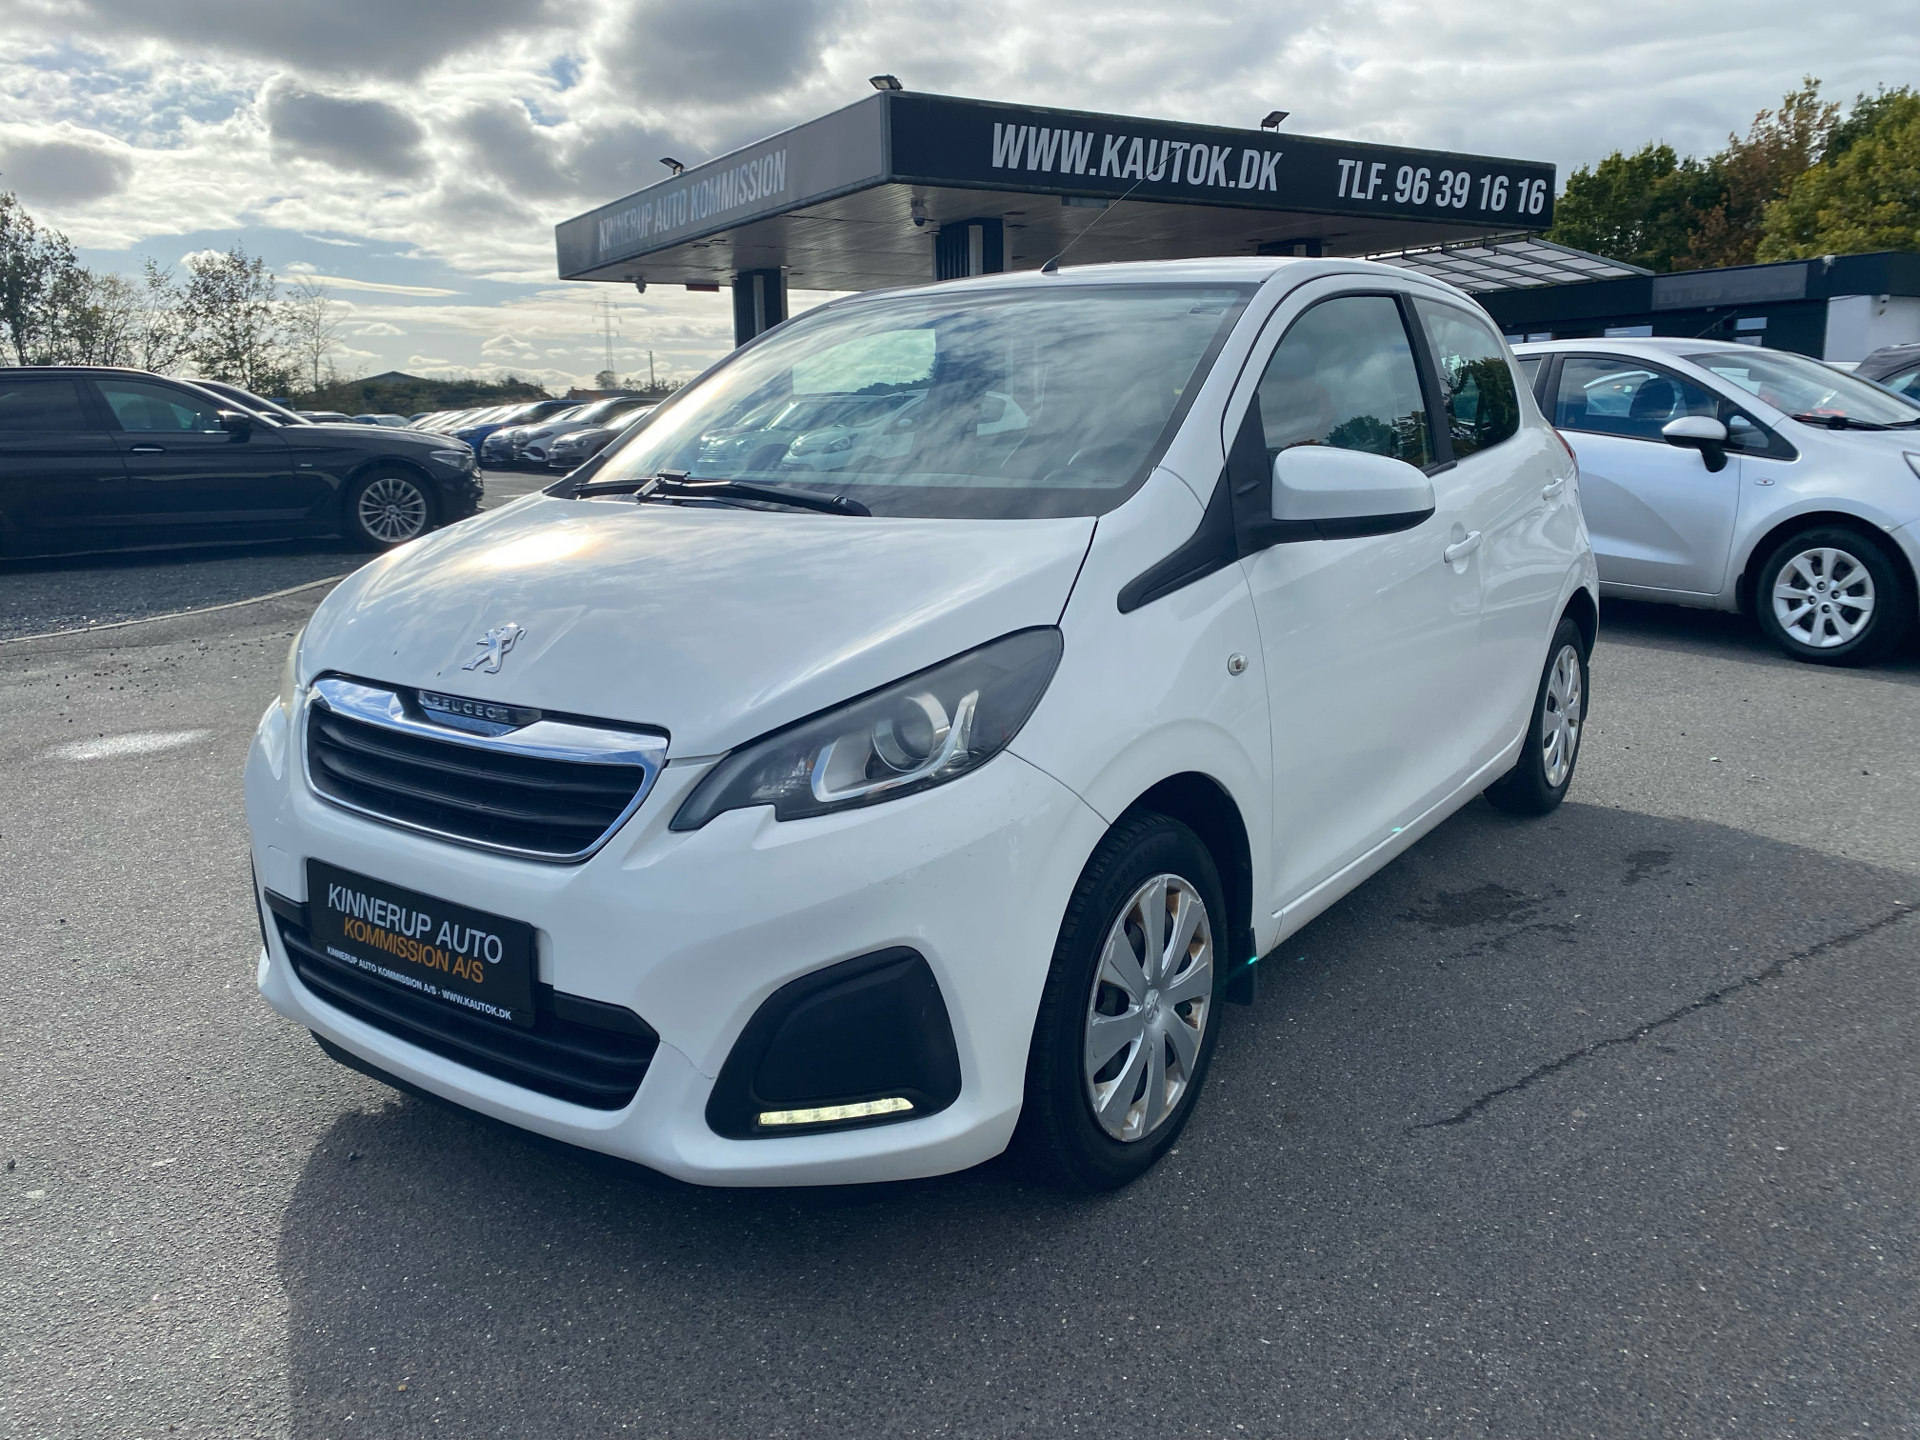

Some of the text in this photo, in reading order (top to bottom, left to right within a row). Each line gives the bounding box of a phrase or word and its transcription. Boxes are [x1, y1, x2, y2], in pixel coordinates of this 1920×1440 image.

[599, 149, 787, 251] KINNERUP AUTO KOMMISSION
[991, 122, 1284, 192] WWW.KAUTOK.DK
[1394, 165, 1432, 205] 96
[1435, 169, 1471, 209] 39
[1480, 174, 1509, 212] 16
[1517, 177, 1547, 215] 16
[432, 696, 508, 721] PEUGEOT
[328, 883, 503, 964] KINNERUP AUTO
[344, 917, 484, 984] KOMMISSION A/S
[327, 945, 358, 965] KINNERUP
[358, 958, 377, 973] AUTO
[377, 964, 423, 991] KOMMISSION
[423, 983, 437, 995] A/S
[441, 989, 512, 1021] WWW.KAUTOK.DK
